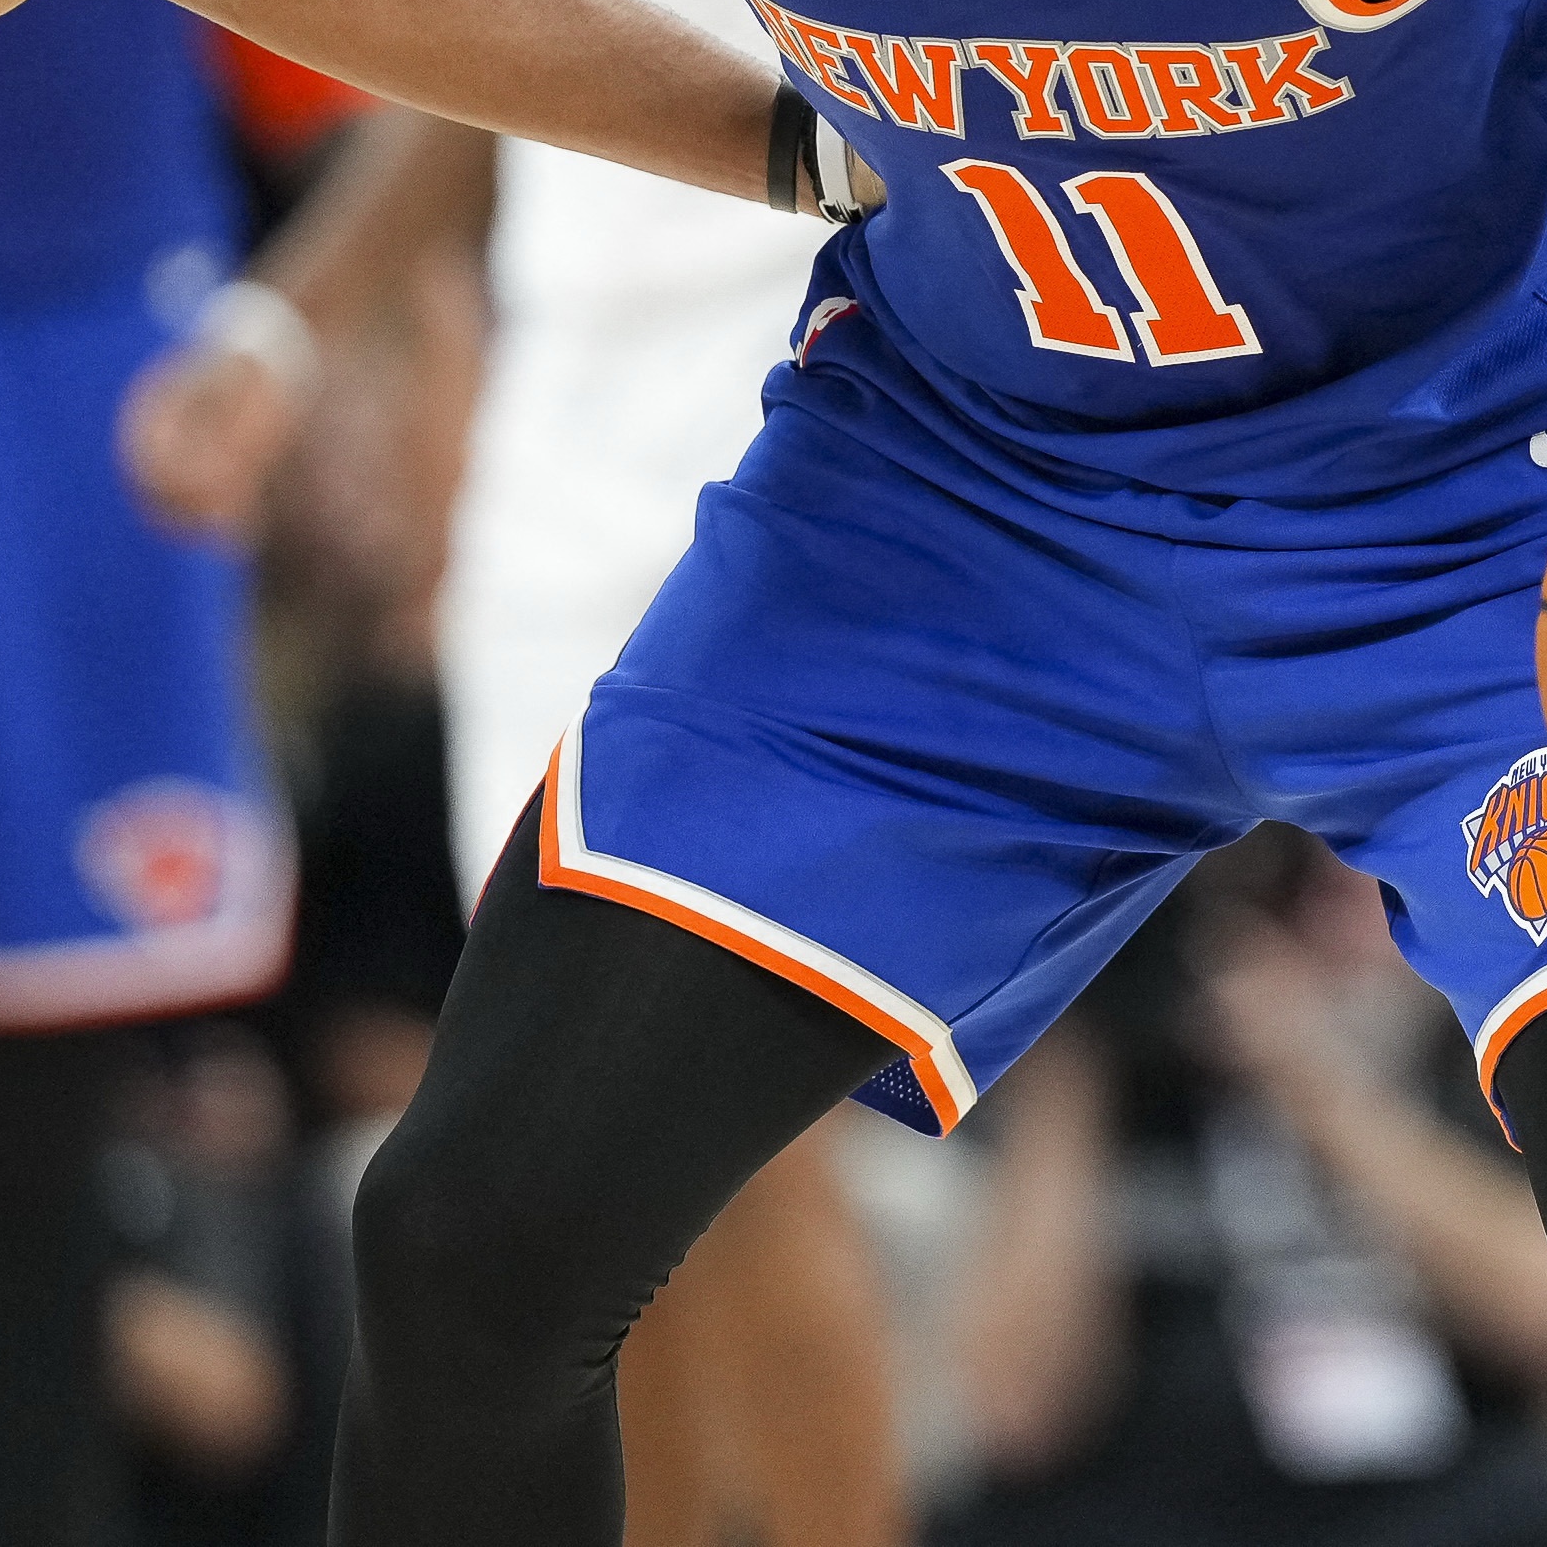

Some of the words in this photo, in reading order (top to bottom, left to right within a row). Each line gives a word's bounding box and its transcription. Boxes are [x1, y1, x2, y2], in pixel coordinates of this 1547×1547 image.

[961, 26, 1355, 141] YORK
[938, 157, 1263, 368] 11
[1510, 756, 1537, 786] NEW
